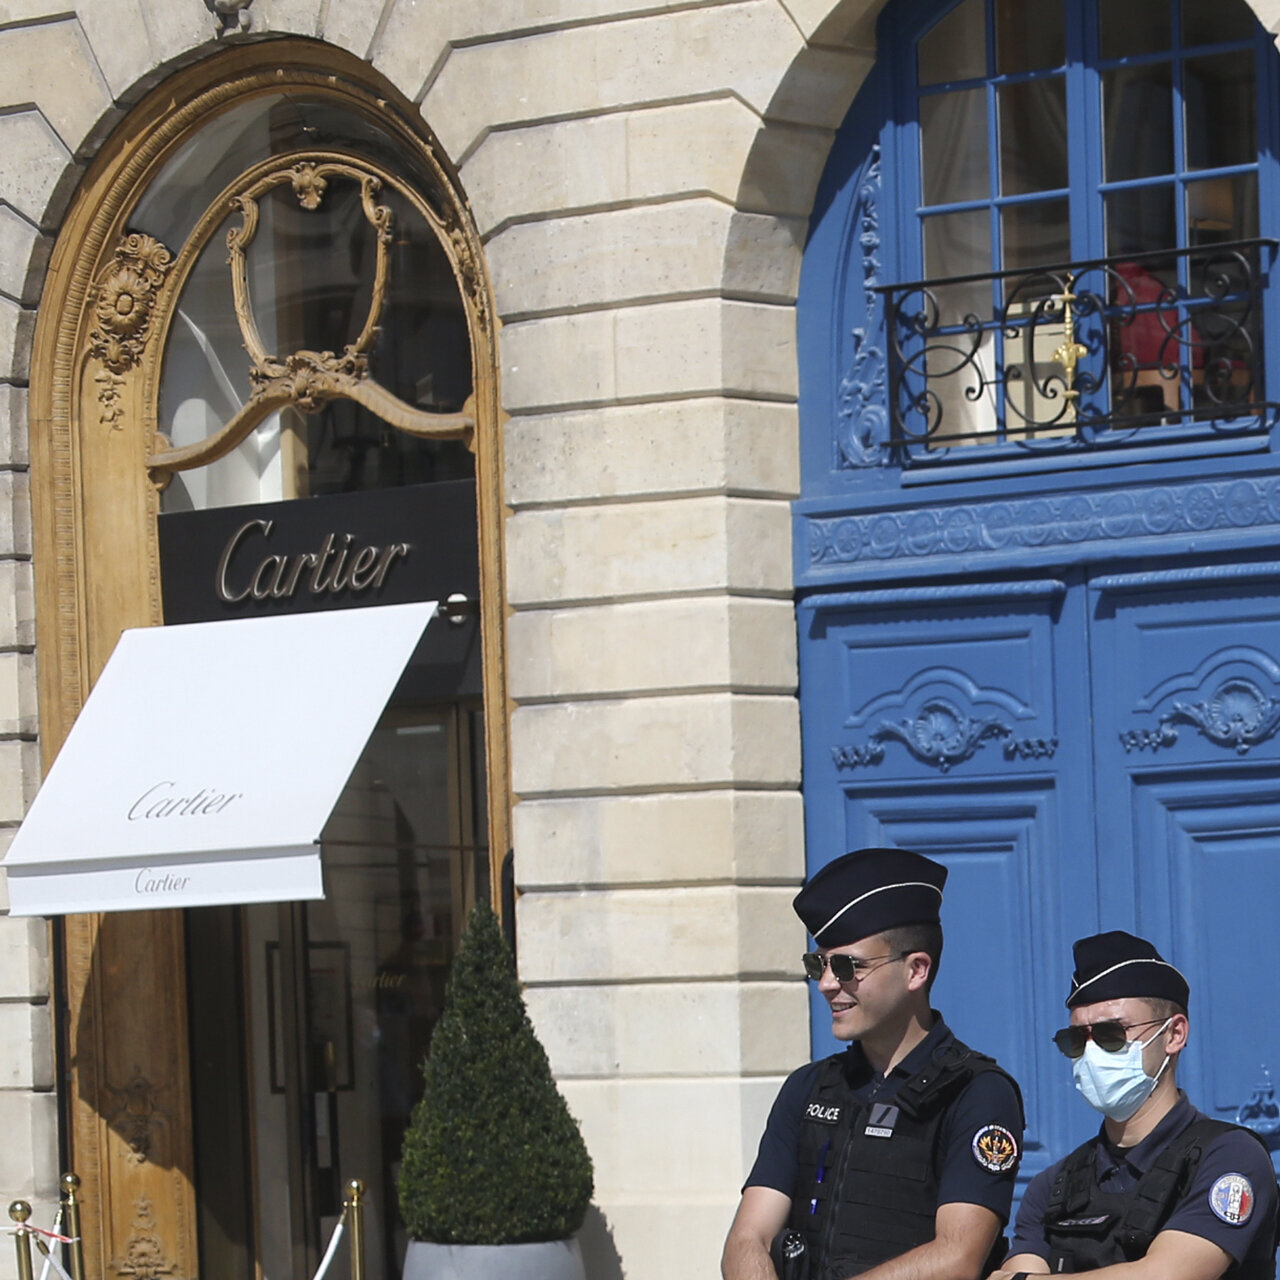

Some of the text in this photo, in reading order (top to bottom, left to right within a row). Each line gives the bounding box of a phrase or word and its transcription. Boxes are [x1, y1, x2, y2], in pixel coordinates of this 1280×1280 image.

[215, 519, 411, 602] Cartier
[128, 780, 243, 821] Cartier
[135, 867, 191, 894] Cartier
